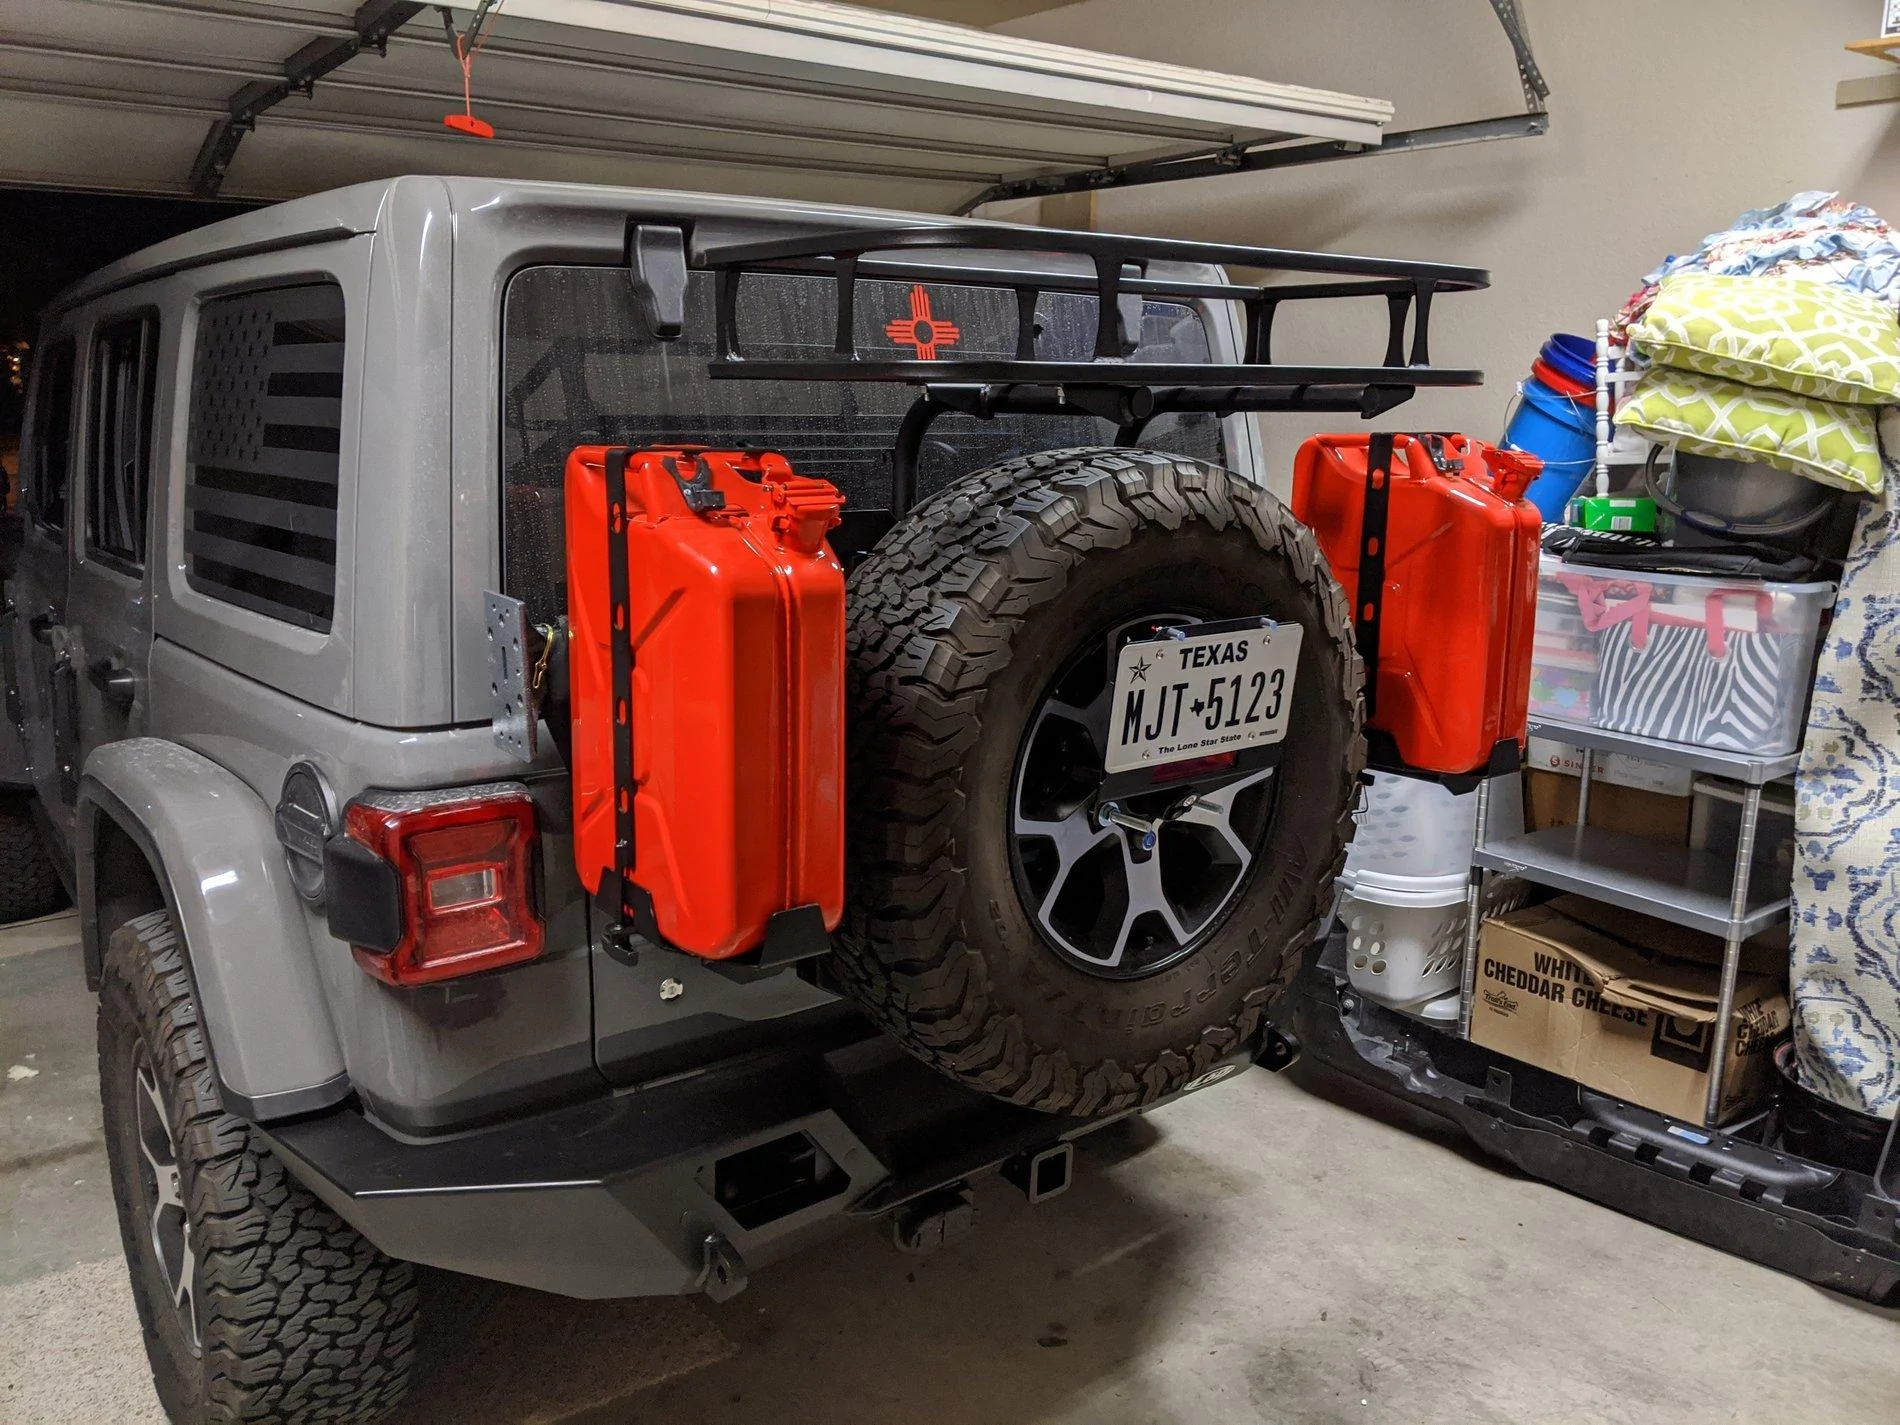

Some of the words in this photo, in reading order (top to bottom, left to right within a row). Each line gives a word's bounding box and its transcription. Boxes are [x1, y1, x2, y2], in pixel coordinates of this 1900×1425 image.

[1179, 640, 1249, 670] TEXAS
[1121, 682, 1190, 746] MJT
[1205, 668, 1286, 731] 5123
[1158, 746, 1175, 755] The
[1177, 741, 1199, 751] Lone
[1201, 737, 1219, 747] Star
[1220, 733, 1242, 743] State
[1484, 958, 1566, 1004] CHEDDAR
